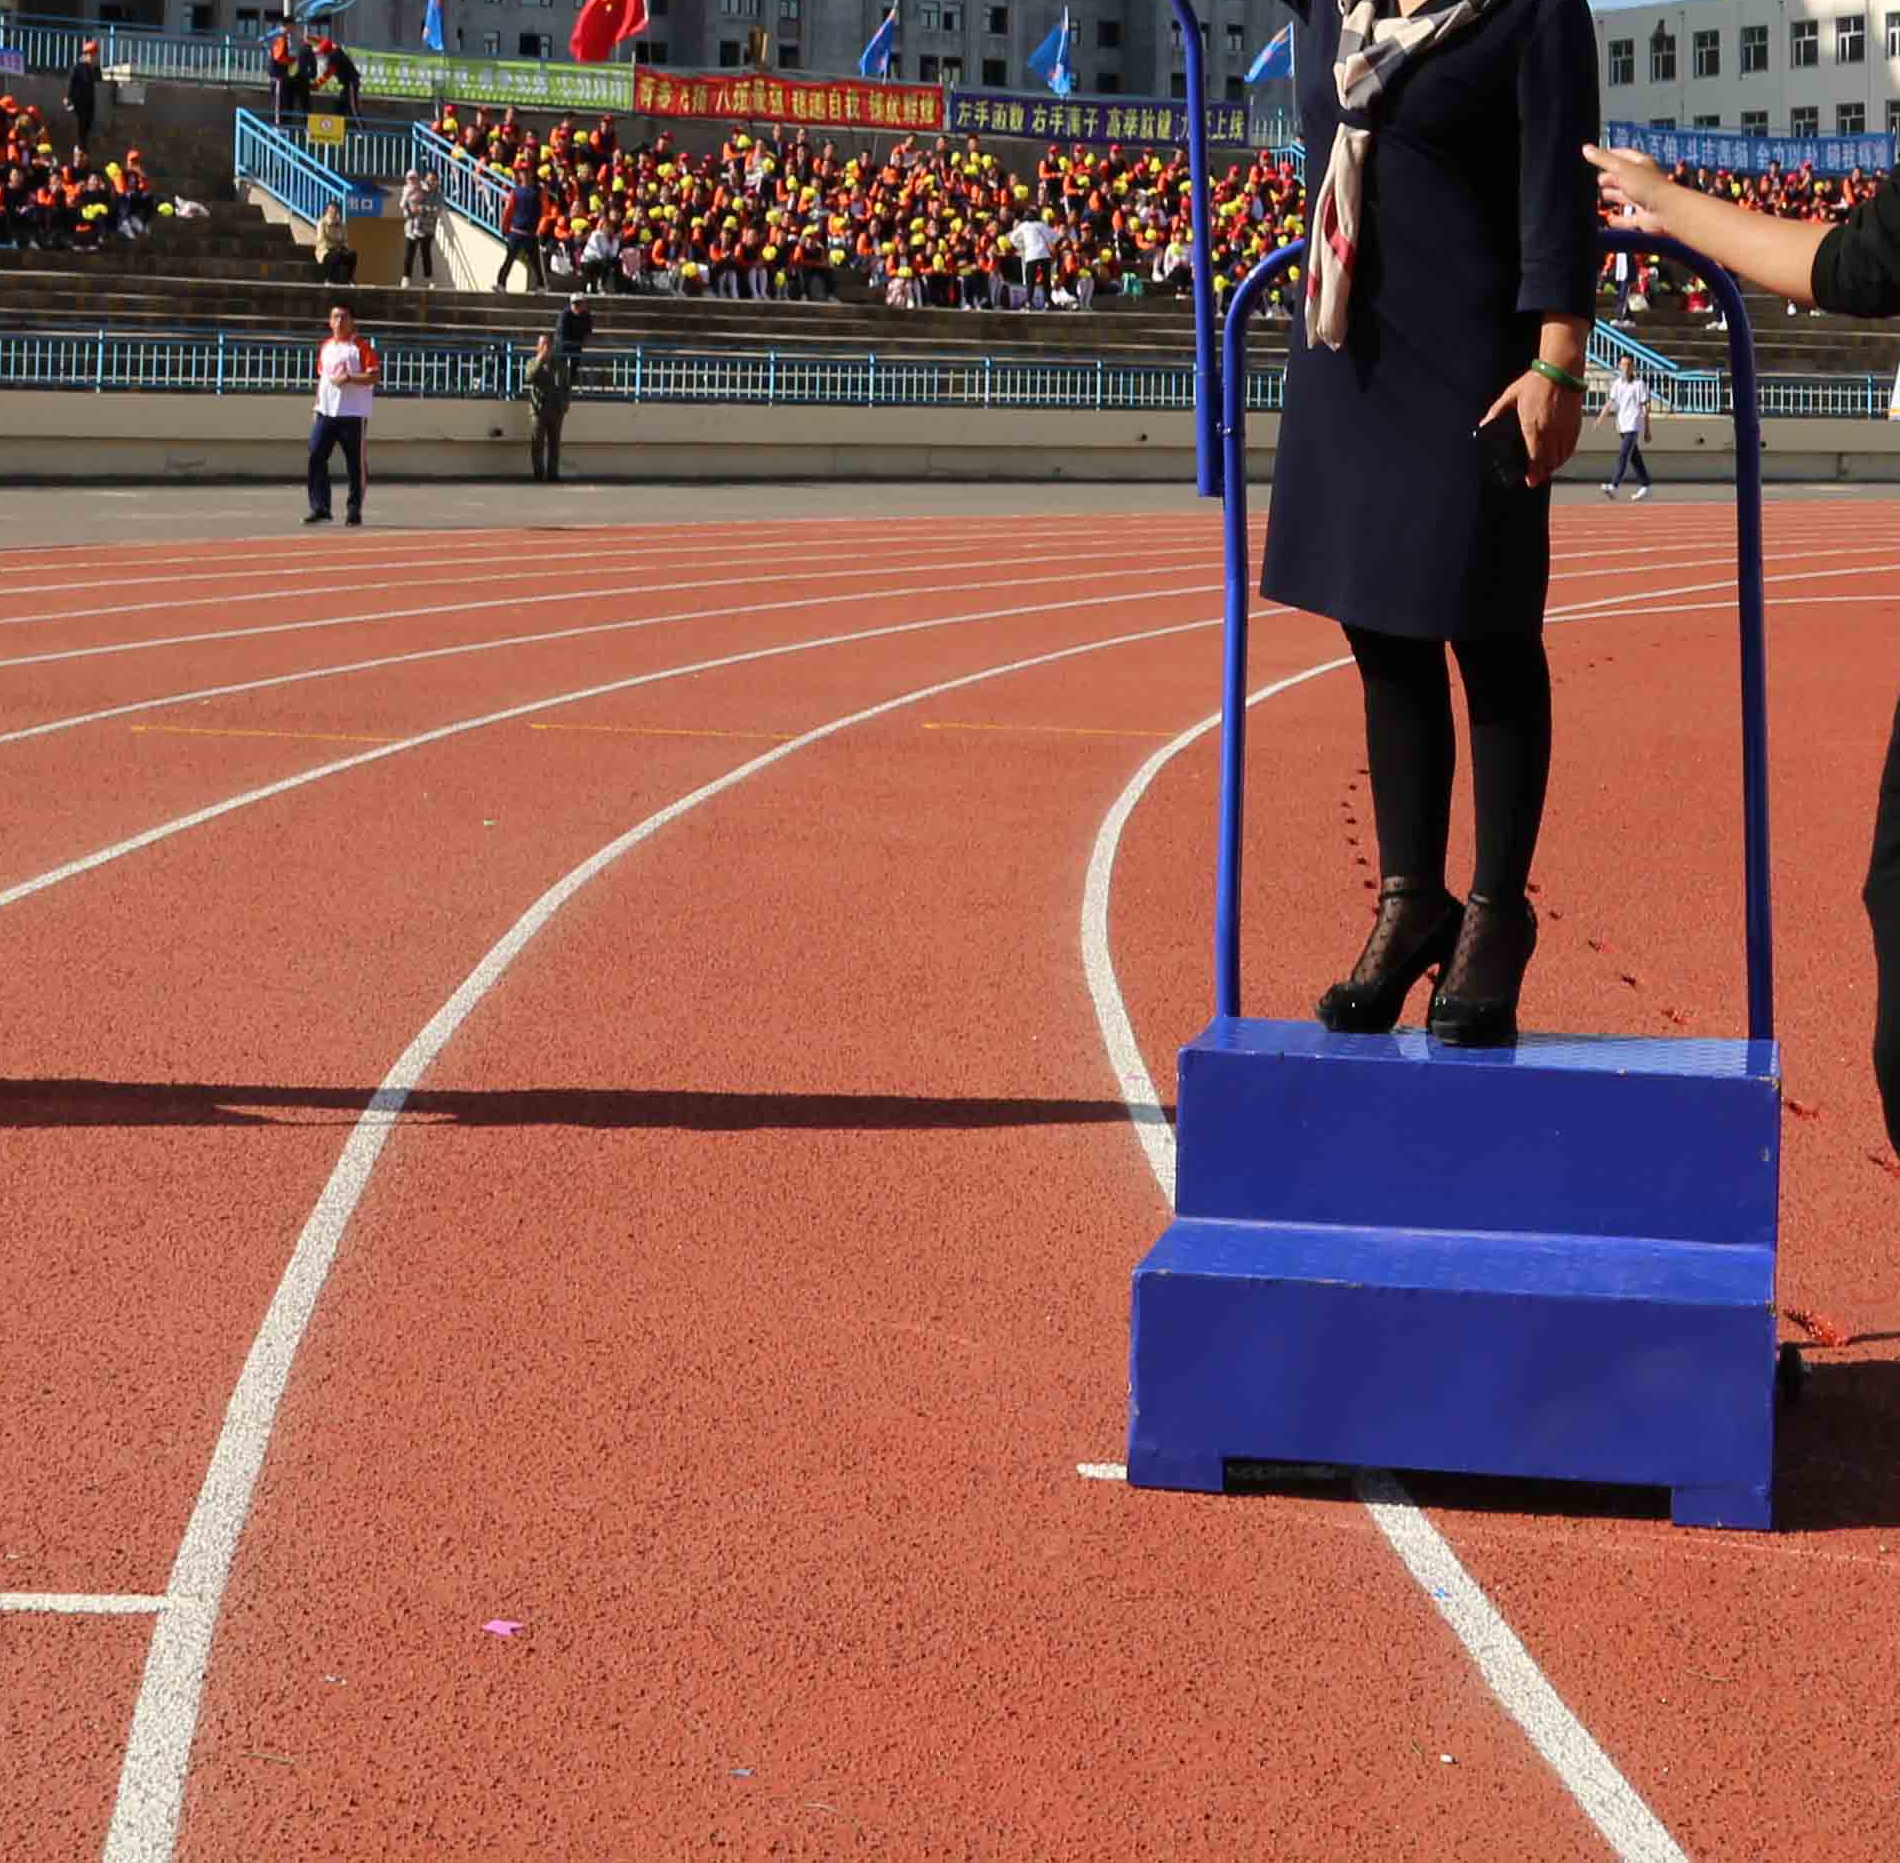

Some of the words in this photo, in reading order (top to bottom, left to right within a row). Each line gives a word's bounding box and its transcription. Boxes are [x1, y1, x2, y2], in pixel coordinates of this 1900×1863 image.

[791, 87, 861, 122] 超越自我
[955, 99, 1025, 134] 左手函数
[1030, 103, 1100, 138] 右手离子
